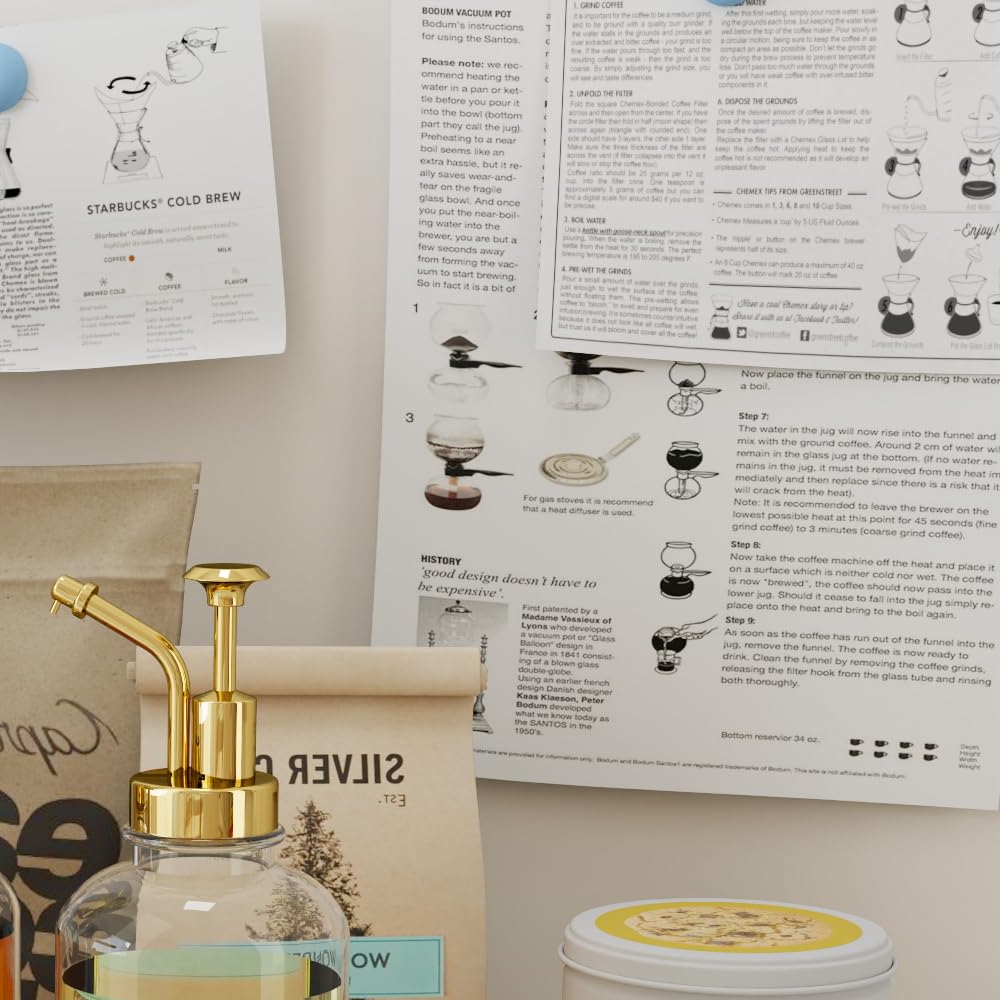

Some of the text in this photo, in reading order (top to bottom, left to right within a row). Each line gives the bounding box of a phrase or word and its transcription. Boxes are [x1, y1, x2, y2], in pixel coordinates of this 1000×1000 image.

[422, 7, 454, 15] BODUM
[422, 20, 466, 29] Bodum's
[422, 58, 455, 66] Please
[467, 73, 502, 82] heating
[168, 195, 201, 207] COLD
[206, 192, 241, 204] BREW
[413, 304, 418, 312] 1
[406, 412, 414, 423] 3
[739, 413, 759, 421] Step
[731, 541, 751, 549] Step
[421, 555, 462, 565] HISTORY
[958, 563, 986, 572] place
[522, 613, 558, 622] Madame
[561, 615, 600, 623] Vassieux
[725, 617, 745, 625] Step
[521, 622, 548, 630] Lyons
[569, 625, 612, 634] developed
[541, 694, 578, 703] Klaeson,
[549, 703, 592, 714] developed
